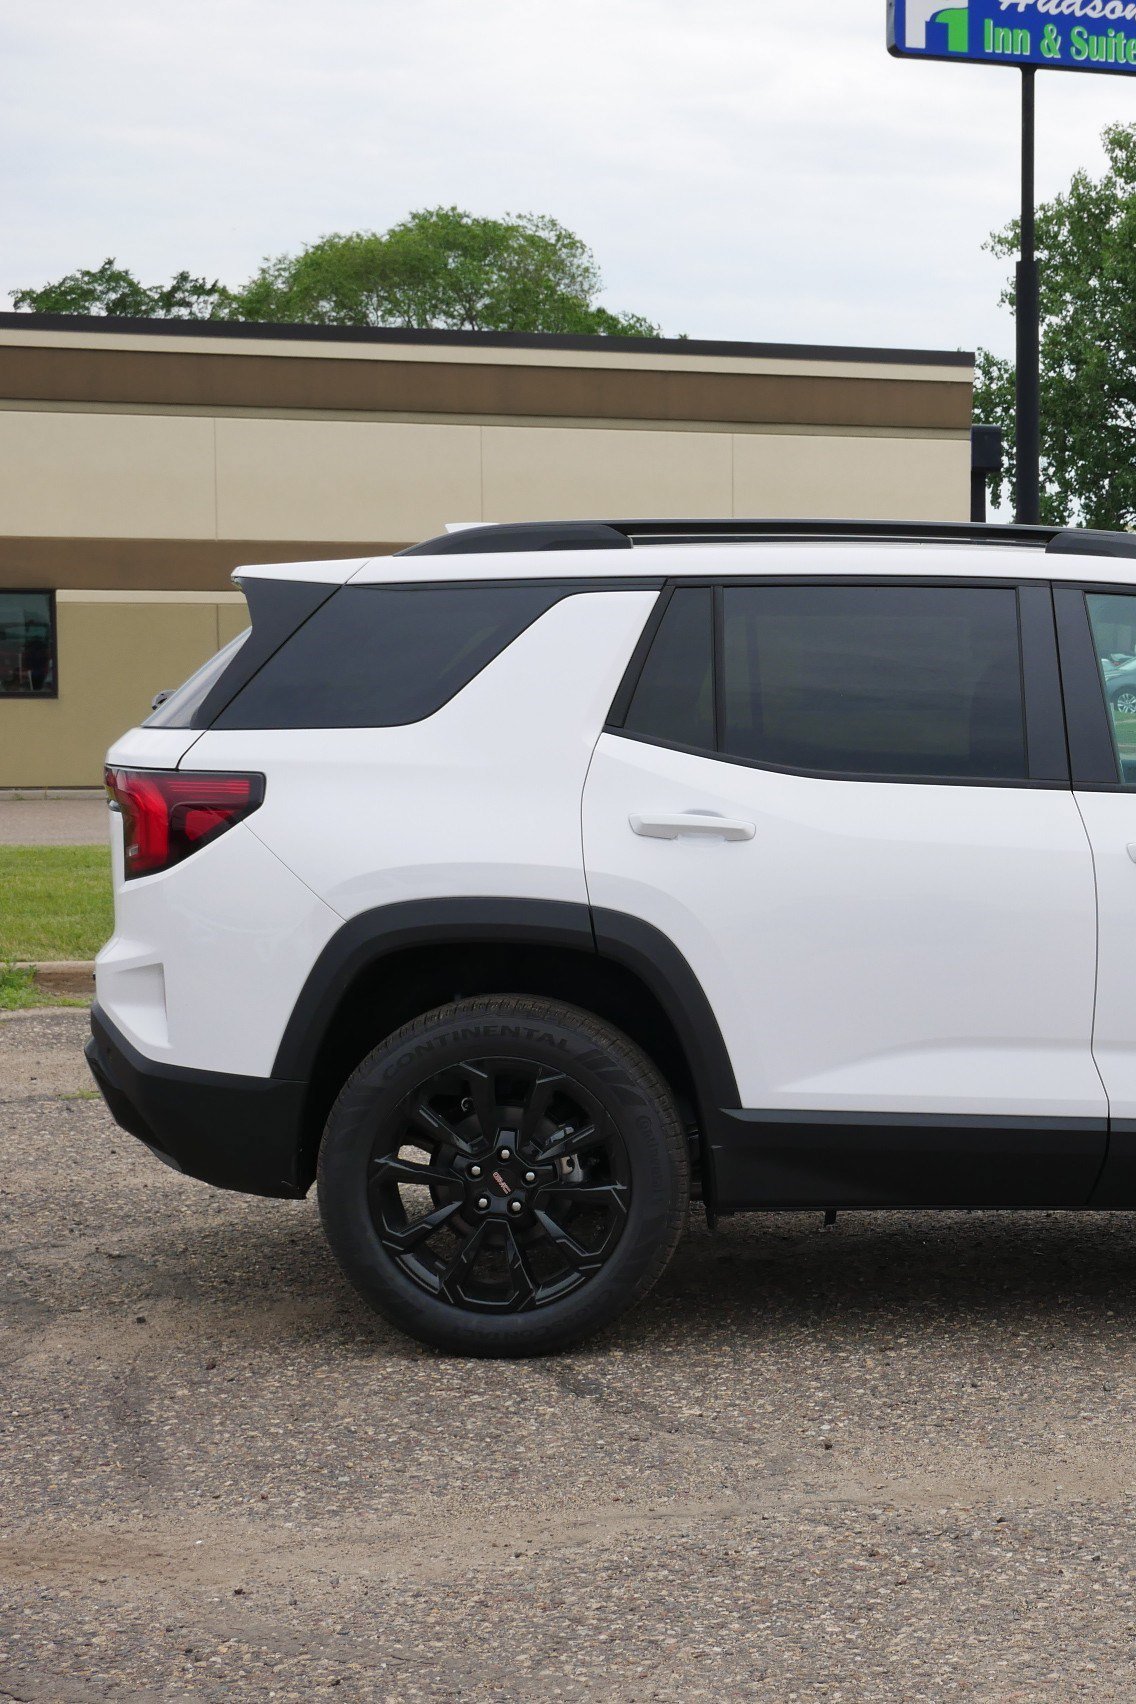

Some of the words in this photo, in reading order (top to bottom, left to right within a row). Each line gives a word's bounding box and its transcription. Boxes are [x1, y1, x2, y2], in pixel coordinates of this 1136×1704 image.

[984, 18, 1031, 55] Inn
[1040, 23, 1062, 58] &
[383, 1025, 570, 1080] CONTINENTAL
